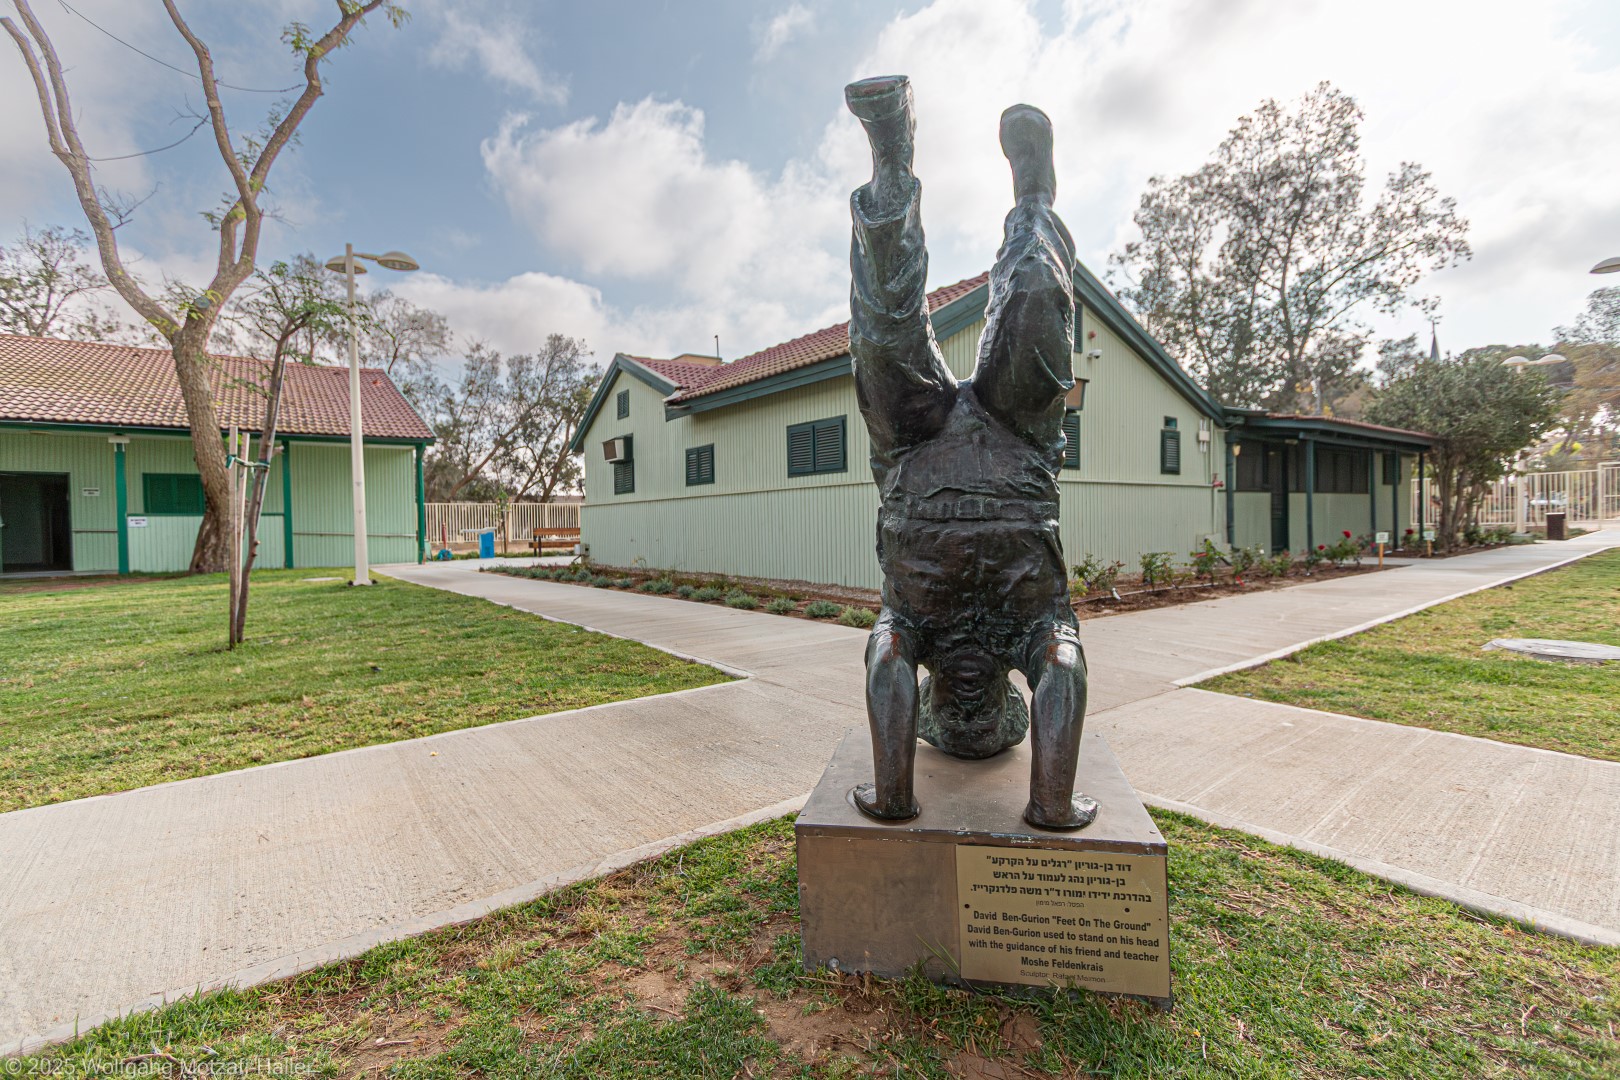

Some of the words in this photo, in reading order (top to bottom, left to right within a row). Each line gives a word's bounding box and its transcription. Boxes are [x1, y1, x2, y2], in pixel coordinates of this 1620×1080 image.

[1026, 857, 1039, 866] על
[1074, 861, 1114, 873] בן-גוריון
[1116, 863, 1132, 872] דוד
[993, 871, 1020, 880] הראש
[1022, 871, 1035, 880] על
[1037, 873, 1066, 882] לעמוד
[1068, 875, 1085, 883] נהג
[1087, 876, 1126, 887] בן-גוריון
[1020, 886, 1042, 895] משה
[1088, 891, 1111, 899] ידידו
[1112, 894, 1152, 903] בהדרכת
[973, 910, 997, 921] David
[1002, 912, 1050, 925] Ben-Gurion
[1052, 915, 1076, 926] "Feet
[1078, 917, 1091, 927] On
[1093, 918, 1111, 928] The
[1113, 920, 1151, 931] Ground"
[967, 924, 991, 934] David
[993, 926, 1041, 938] Ben-Gurion
[1043, 930, 1065, 940] used
[1067, 931, 1077, 940] to
[1078, 932, 1104, 943] stand
[1106, 936, 1118, 944] on
[1120, 935, 1134, 945] his
[1136, 936, 1160, 947] head
[969, 938, 988, 948] with
[990, 940, 1004, 949] the
[1006, 941, 1046, 953] guidance
[1048, 944, 1058, 953] of
[1059, 945, 1073, 955] his
[1075, 946, 1101, 957] friend
[1103, 949, 1121, 959] and
[1123, 951, 1160, 962] teacher
[1021, 956, 1050, 967] Moshe
[1052, 958, 1104, 972] Feldenkrais
